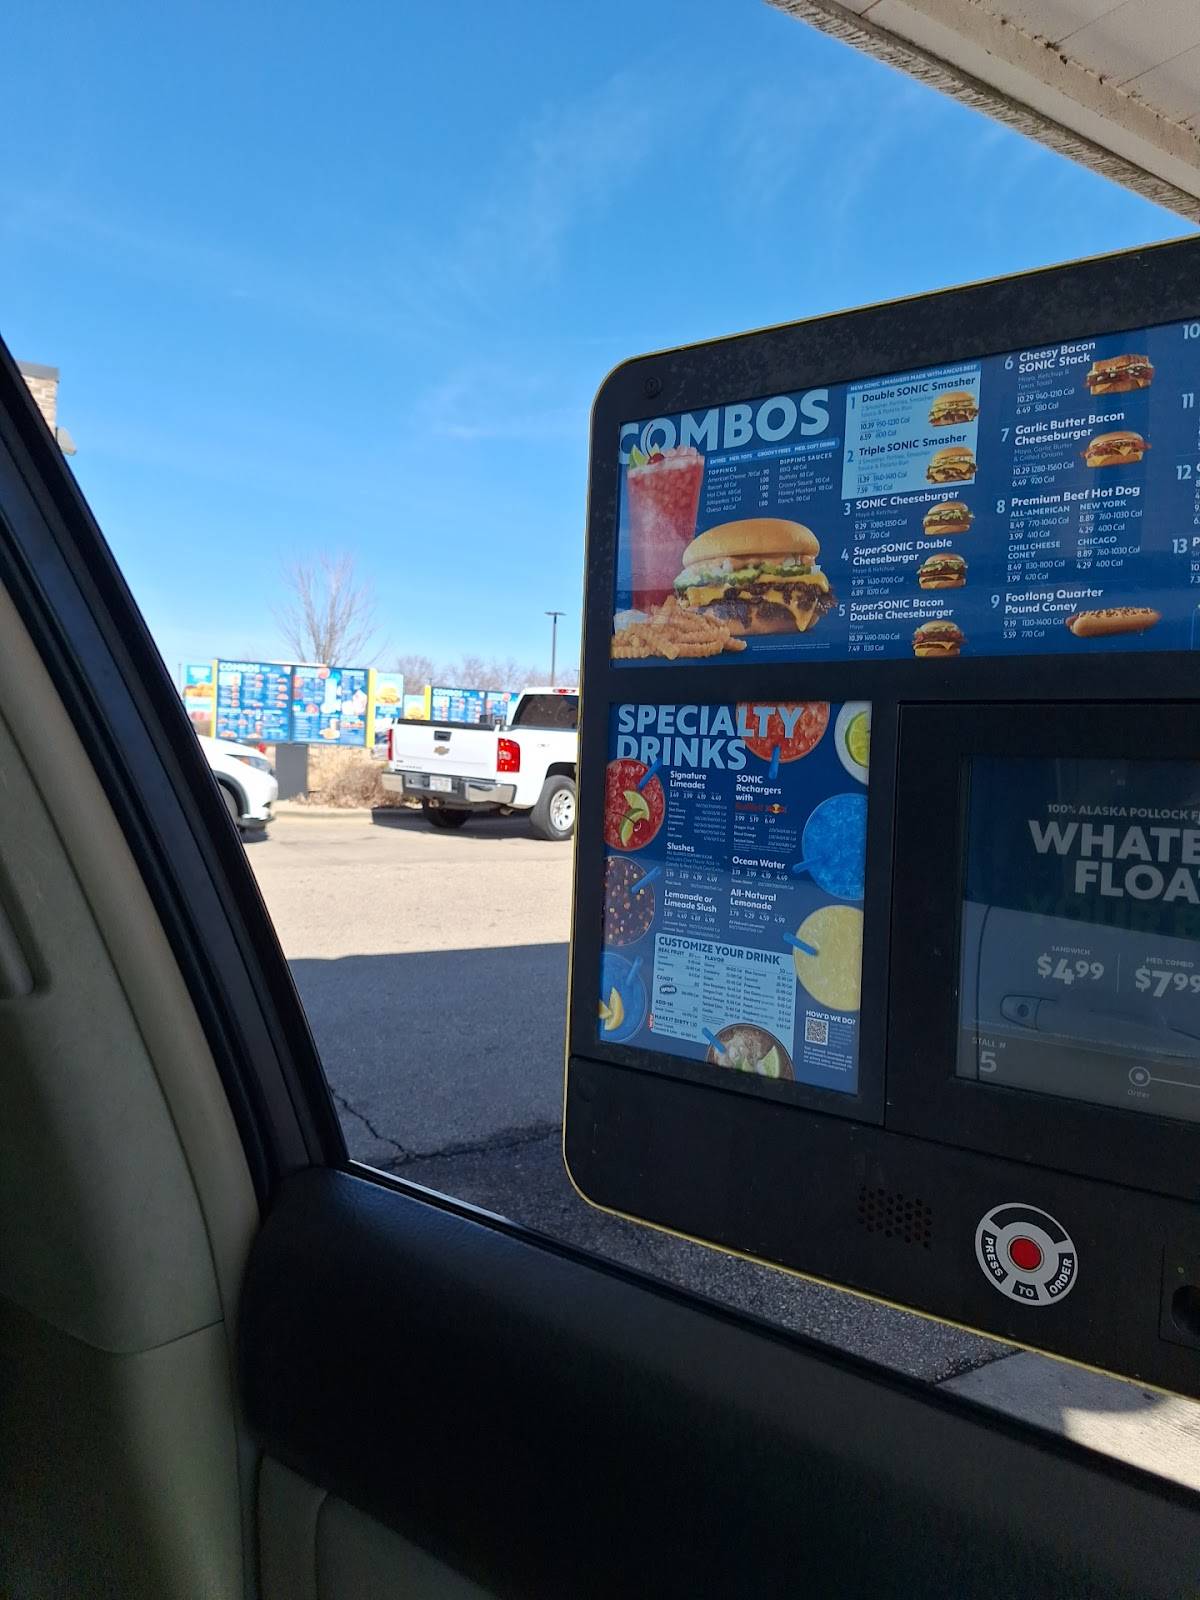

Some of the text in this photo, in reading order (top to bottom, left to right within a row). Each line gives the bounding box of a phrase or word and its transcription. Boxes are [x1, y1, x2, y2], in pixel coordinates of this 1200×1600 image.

[1183, 323, 1200, 339] 10
[1020, 342, 1095, 361] Cheesy Bacon
[1005, 356, 1013, 369] 6
[1019, 353, 1090, 373] SONIC Stack
[862, 377, 976, 402] Double SONIC Smasher
[851, 397, 855, 409] 1
[1017, 395, 1034, 403] 10.29
[1182, 393, 1194, 408] 11
[620, 389, 829, 464] COMBOS
[1015, 412, 1125, 435] Garlic Butter Bacon
[1001, 428, 1009, 442] 7
[1015, 428, 1093, 445] Cheeseburger
[859, 434, 967, 457] Triple SONIC Smasher
[780, 453, 832, 464] DIPPING SAUCES
[847, 450, 854, 462] 2
[708, 466, 736, 475] TOPPINGS
[1013, 467, 1030, 475] 10.29
[1176, 465, 1191, 480] 12
[856, 491, 959, 509] SONIC Cheeseburger
[1011, 486, 1140, 506] Premium Beef Hot Dog
[843, 503, 851, 515] 3
[996, 500, 1005, 514] 8
[1102, 500, 1126, 508] YORK
[1011, 506, 1070, 517] ALL-AMERICAN
[1131, 510, 1142, 518] Cal
[1008, 541, 1060, 552] CHILI CHEESE
[1078, 536, 1117, 545] CHICAGO
[1172, 539, 1187, 553] 13
[853, 539, 952, 556] SuperSONIC Double
[841, 549, 849, 560] 4
[853, 554, 918, 566] Cheeseburger
[991, 595, 999, 608] 9
[1006, 588, 1103, 602] Footlong Quarter
[839, 604, 845, 616] 5
[851, 599, 944, 612] SuperSONIC Bacon
[1005, 603, 1077, 614] Pound Coney
[850, 609, 954, 621] Double Cheeseburger
[618, 704, 804, 739] SPECIALTY
[616, 736, 747, 770] DRINKS
[670, 771, 707, 780] Signature
[736, 775, 763, 783] SONIC
[670, 780, 705, 789] Limeades
[736, 784, 781, 795] Rechargers
[1048, 804, 1076, 815] 100%
[1079, 805, 1127, 817] ALASKA
[1129, 807, 1187, 820] POLLOCK
[667, 842, 694, 852] Slushes
[733, 856, 758, 866] Ocean
[760, 859, 785, 869] Water
[665, 890, 703, 902] Lemonade
[731, 889, 776, 901] All-Natural
[664, 899, 717, 913] Limeade Slush
[730, 898, 772, 910] Lemonade
[659, 936, 713, 954] CUSTOMIZE
[715, 946, 744, 960] YOUR
[746, 952, 780, 965] DRINK
[1052, 945, 1090, 956] SANDWICH
[806, 1010, 829, 1020] HOW'D
[980, 1051, 996, 1072] 5
[985, 1237, 1003, 1277] PRESS
[1049, 1258, 1072, 1294] ORDER
[1019, 1285, 1034, 1297] TO
